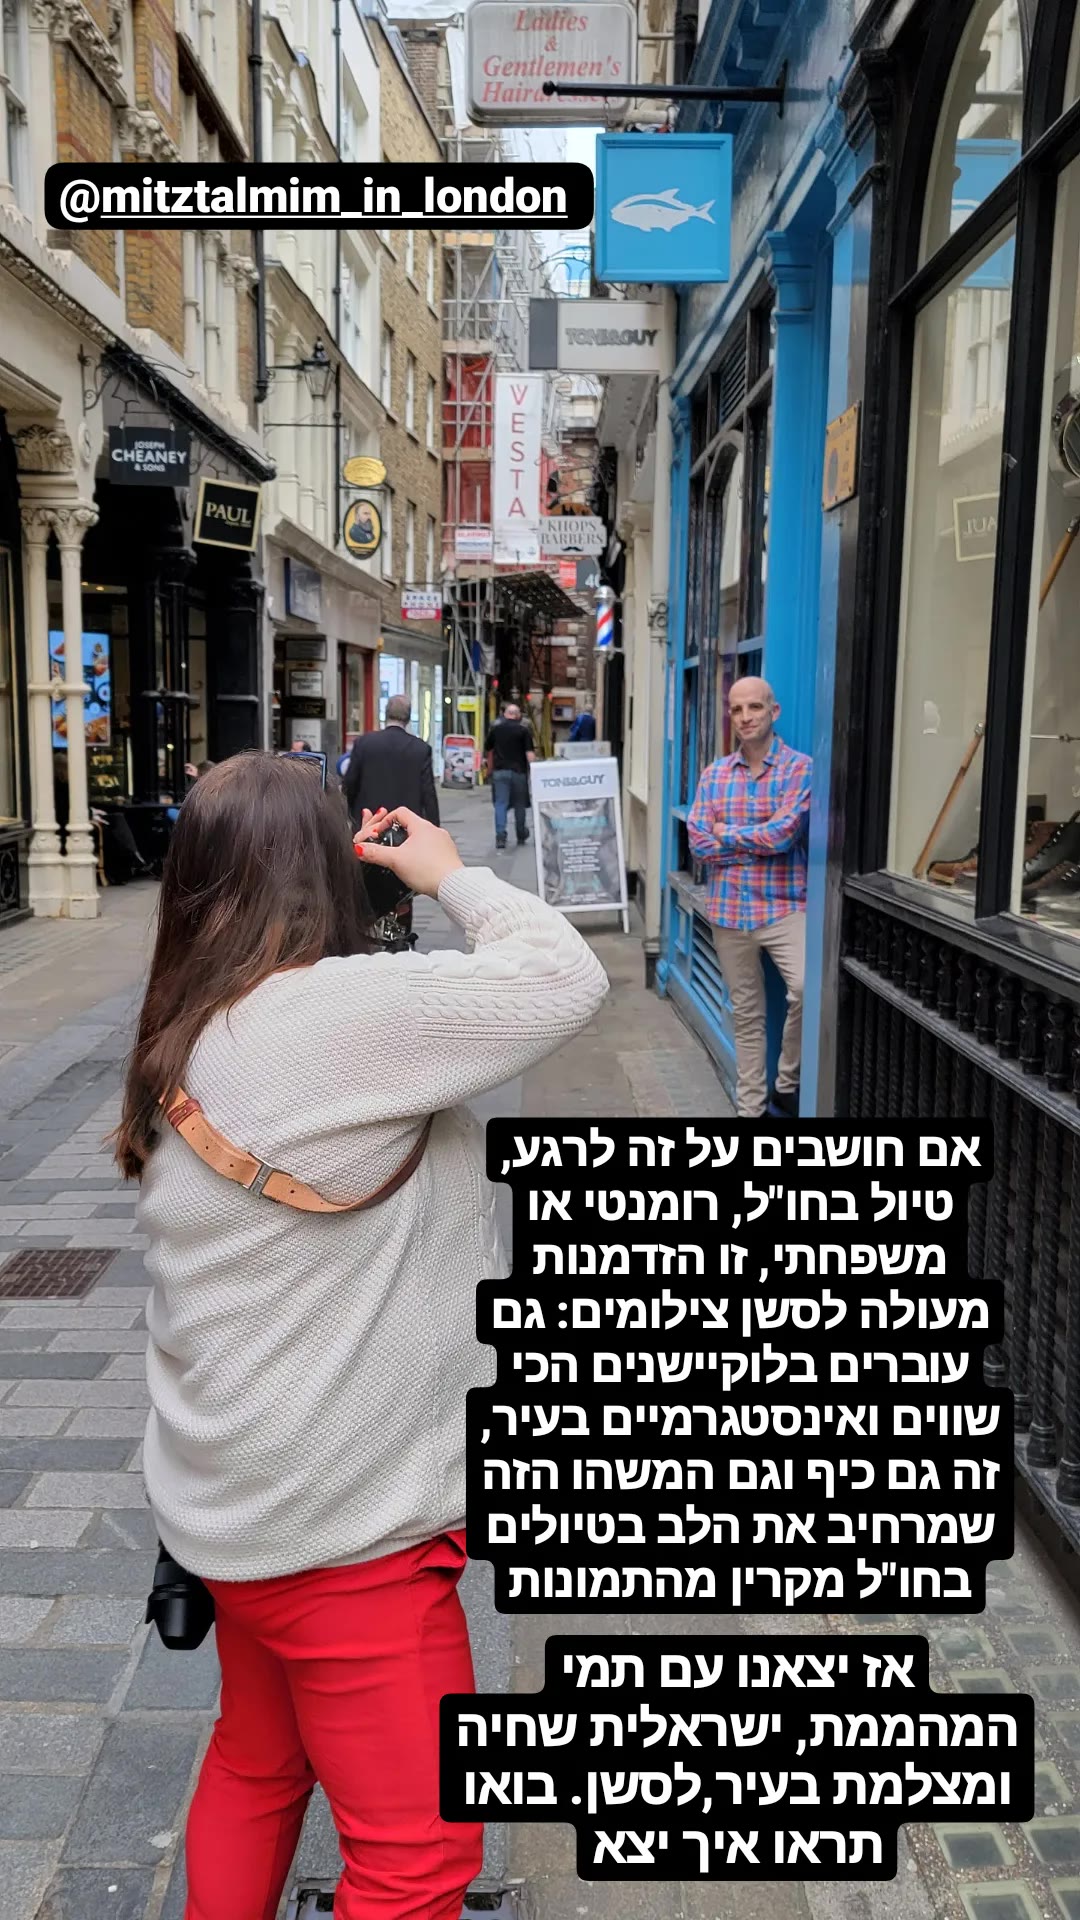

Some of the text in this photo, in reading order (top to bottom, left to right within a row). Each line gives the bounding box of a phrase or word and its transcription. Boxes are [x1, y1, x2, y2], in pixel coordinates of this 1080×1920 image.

[513, 9, 588, 32] Ladies
[544, 35, 558, 52] &
[483, 55, 622, 77] Gentlemen's
[134, 440, 166, 450] JOSEPH
[508, 383, 528, 518] VESTA
[111, 448, 187, 464] CHEANEY
[134, 463, 166, 472] & SONS
[205, 501, 252, 524] PAUL
[541, 532, 604, 545] BARBERS
